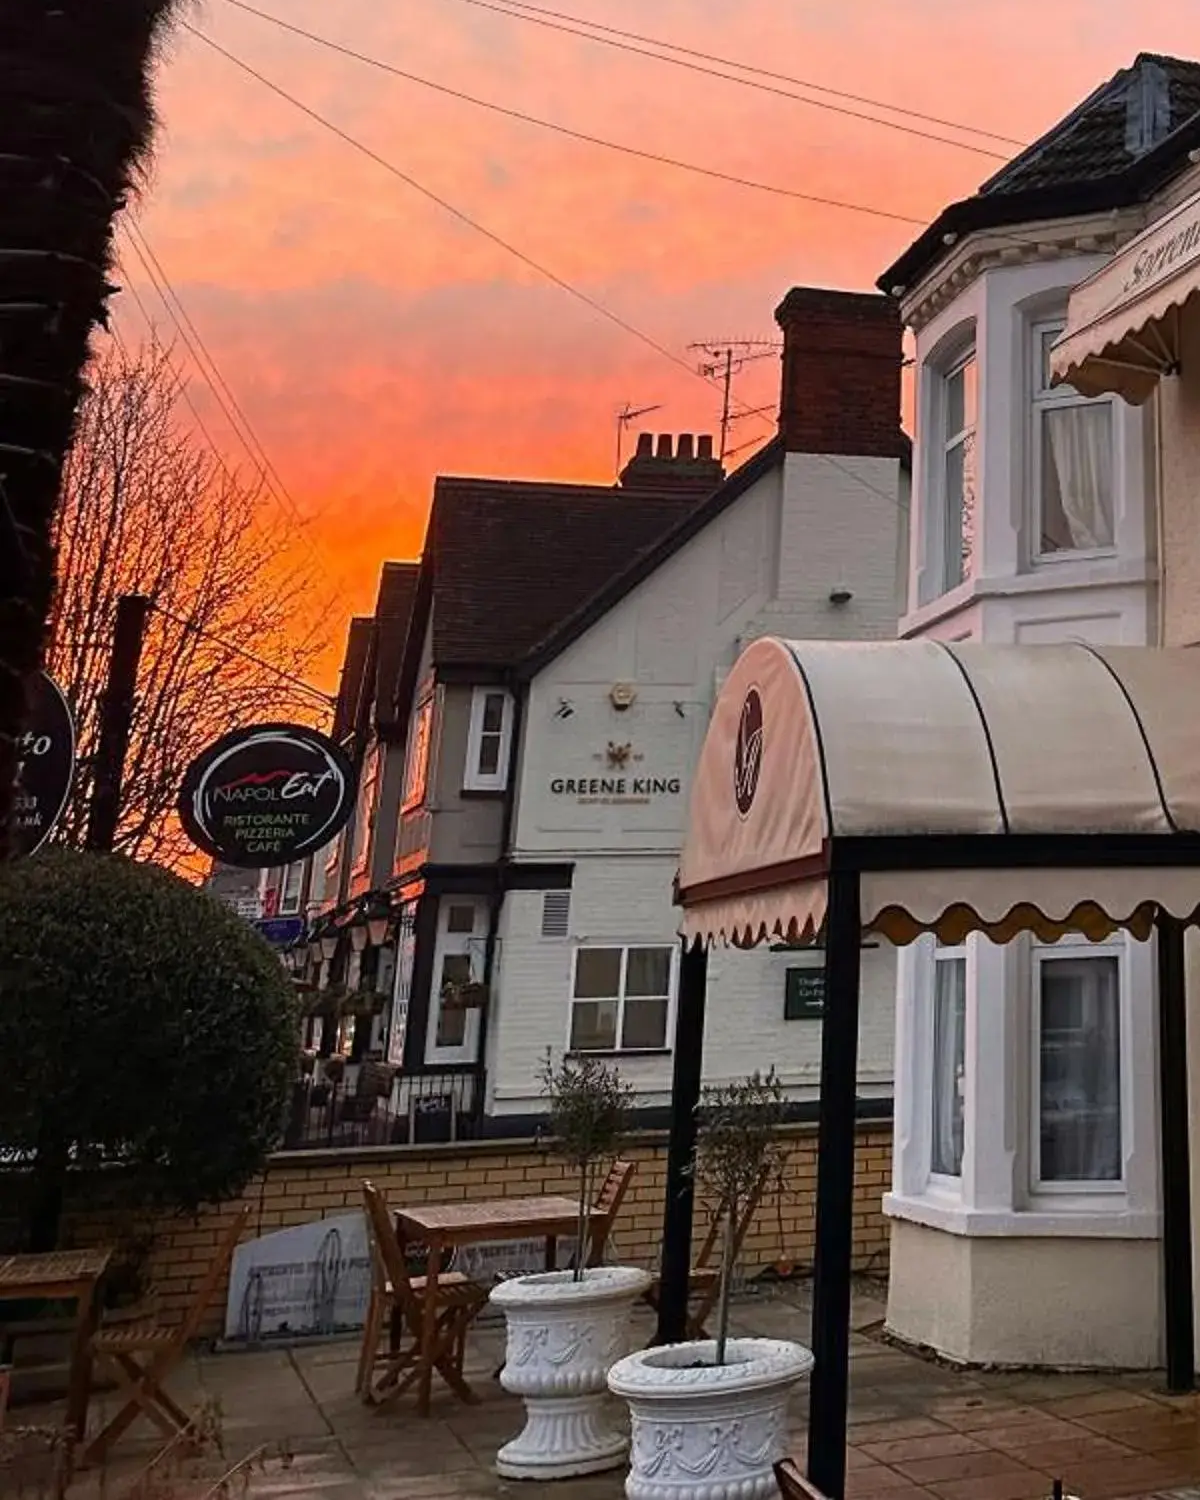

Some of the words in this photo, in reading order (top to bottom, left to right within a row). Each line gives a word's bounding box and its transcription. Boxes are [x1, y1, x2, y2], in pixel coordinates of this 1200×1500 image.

[551, 778, 626, 795] GREENE
[633, 778, 681, 795] KING
[223, 812, 311, 827] RISTORANTE
[235, 827, 296, 840] PIZZERIA
